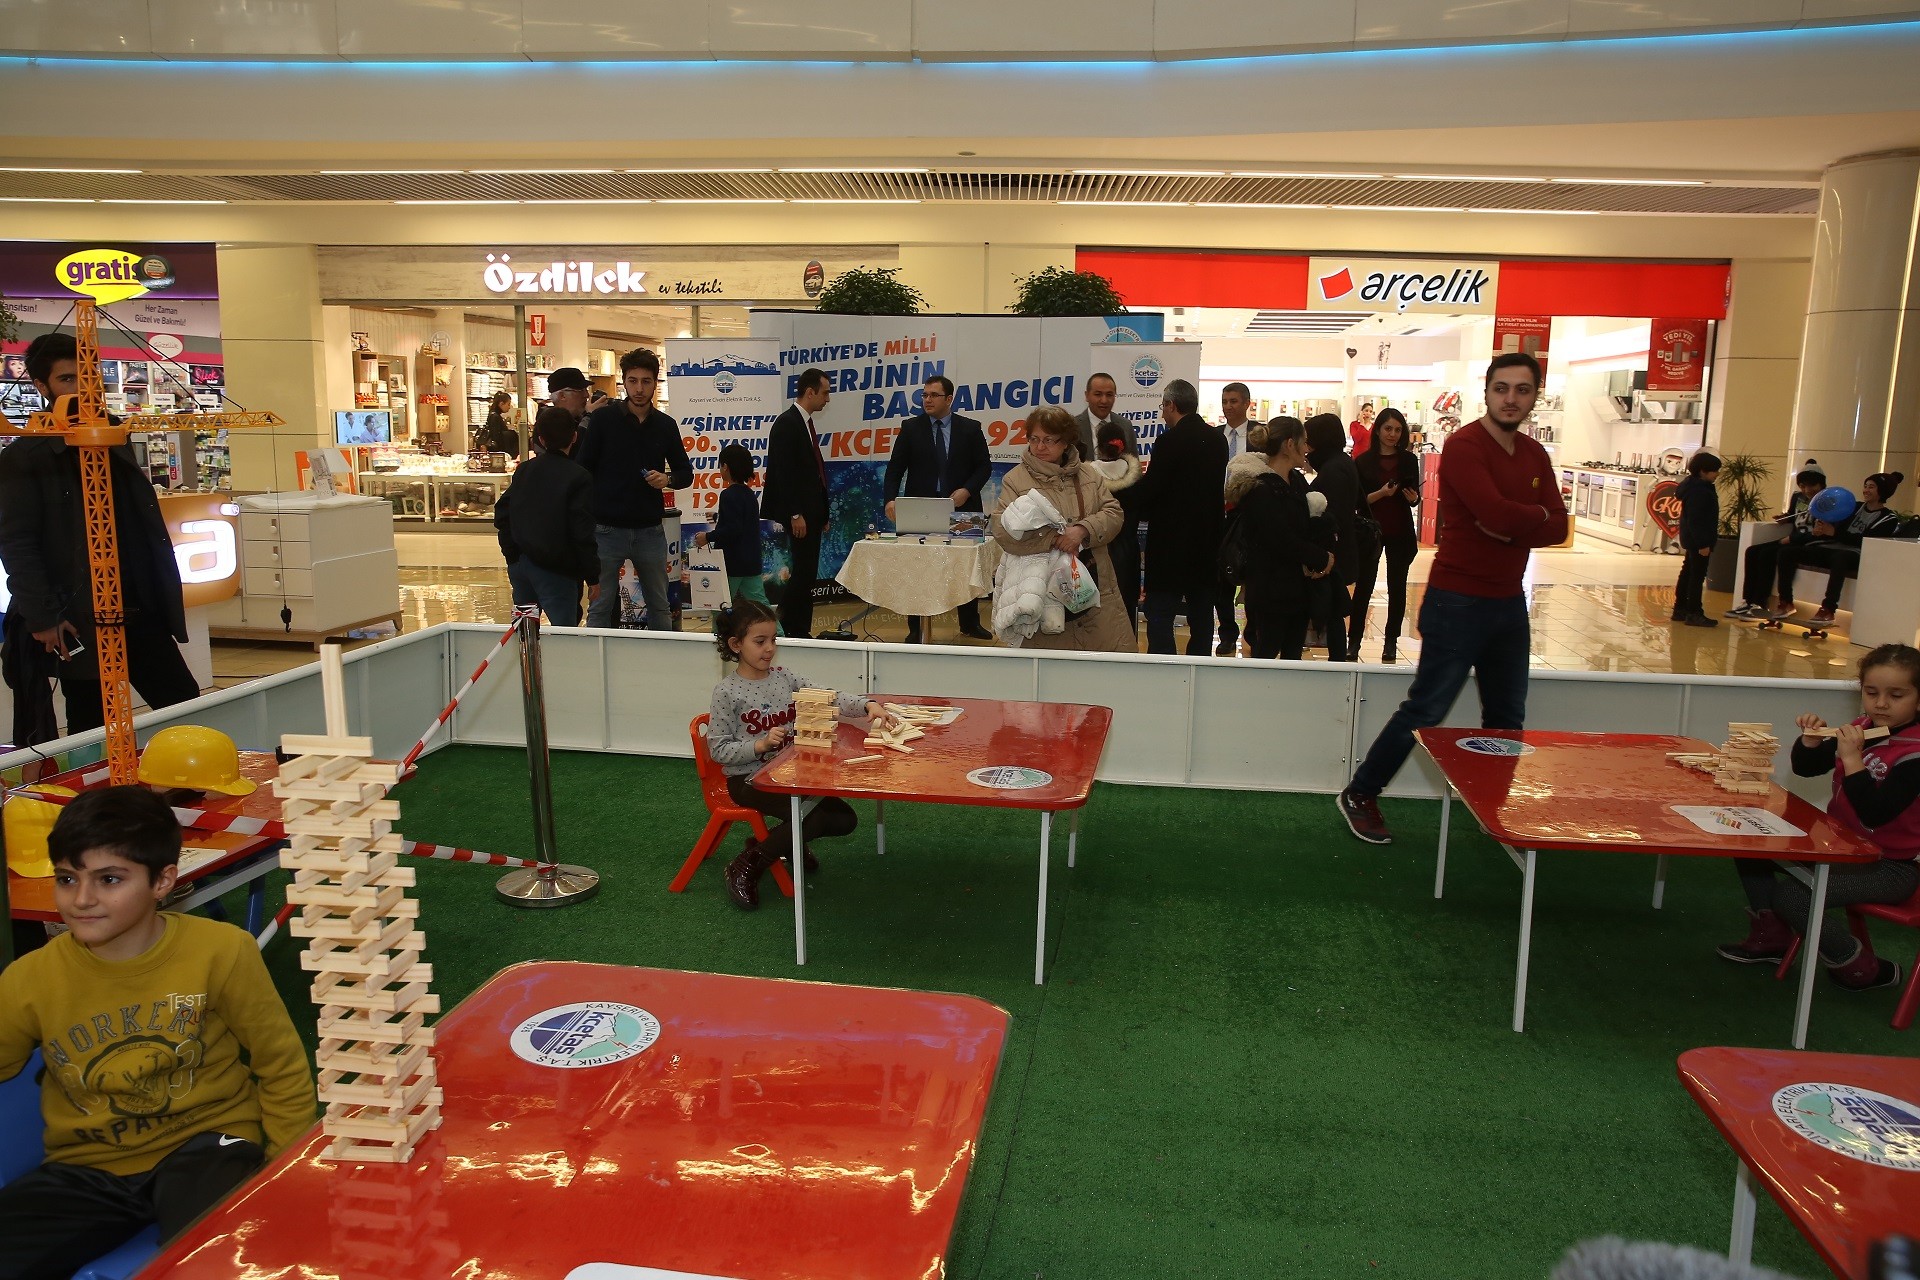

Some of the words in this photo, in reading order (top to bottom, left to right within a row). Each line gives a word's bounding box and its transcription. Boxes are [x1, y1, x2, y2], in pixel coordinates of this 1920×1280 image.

[483, 253, 648, 293] Özdilek
[658, 283, 671, 294] ev
[675, 278, 723, 295] tekstili
[1360, 268, 1490, 309] arçelik
[145, 304, 156, 313] Her
[156, 306, 178, 315] Zaman
[135, 314, 151, 324] Güzel
[779, 342, 878, 367] TÜRKİYE'DE
[884, 332, 937, 356] MİLLİ
[693, 492, 718, 509] 19
[831, 585, 844, 595] ve
[586, 1003, 643, 1015] KAYSERİ
[554, 1011, 613, 1055] kcetaş
